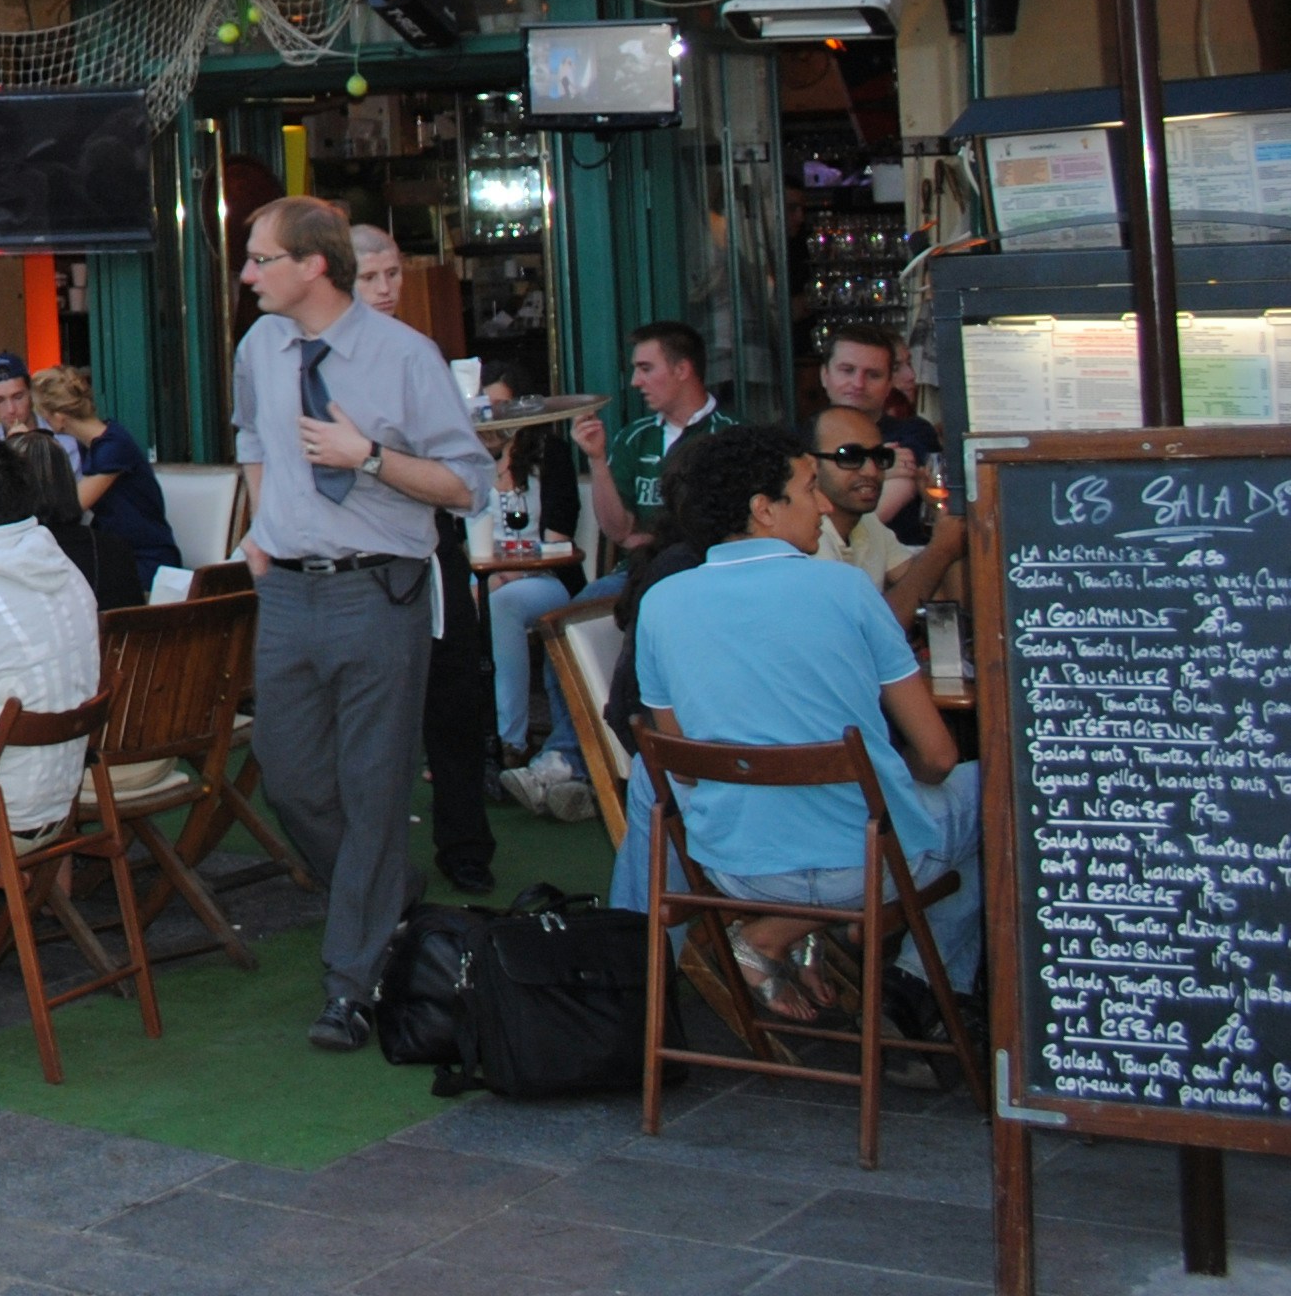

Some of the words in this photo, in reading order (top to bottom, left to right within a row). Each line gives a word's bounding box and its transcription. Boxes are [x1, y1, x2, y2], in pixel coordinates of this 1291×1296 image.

[1051, 475, 1113, 526] LES
[1141, 475, 1291, 525] SALADE
[1020, 545, 1041, 562] LA
[1024, 608, 1041, 625] LA
[1047, 602, 1186, 627] GOURMANDE
[1031, 666, 1053, 685] LA
[1035, 718, 1056, 736] LA
[1048, 798, 1070, 817] LA
[1059, 881, 1080, 901] LA
[1060, 936, 1081, 956] LA
[1090, 937, 1195, 964] BOUGNAT
[1065, 1016, 1090, 1035] LA
